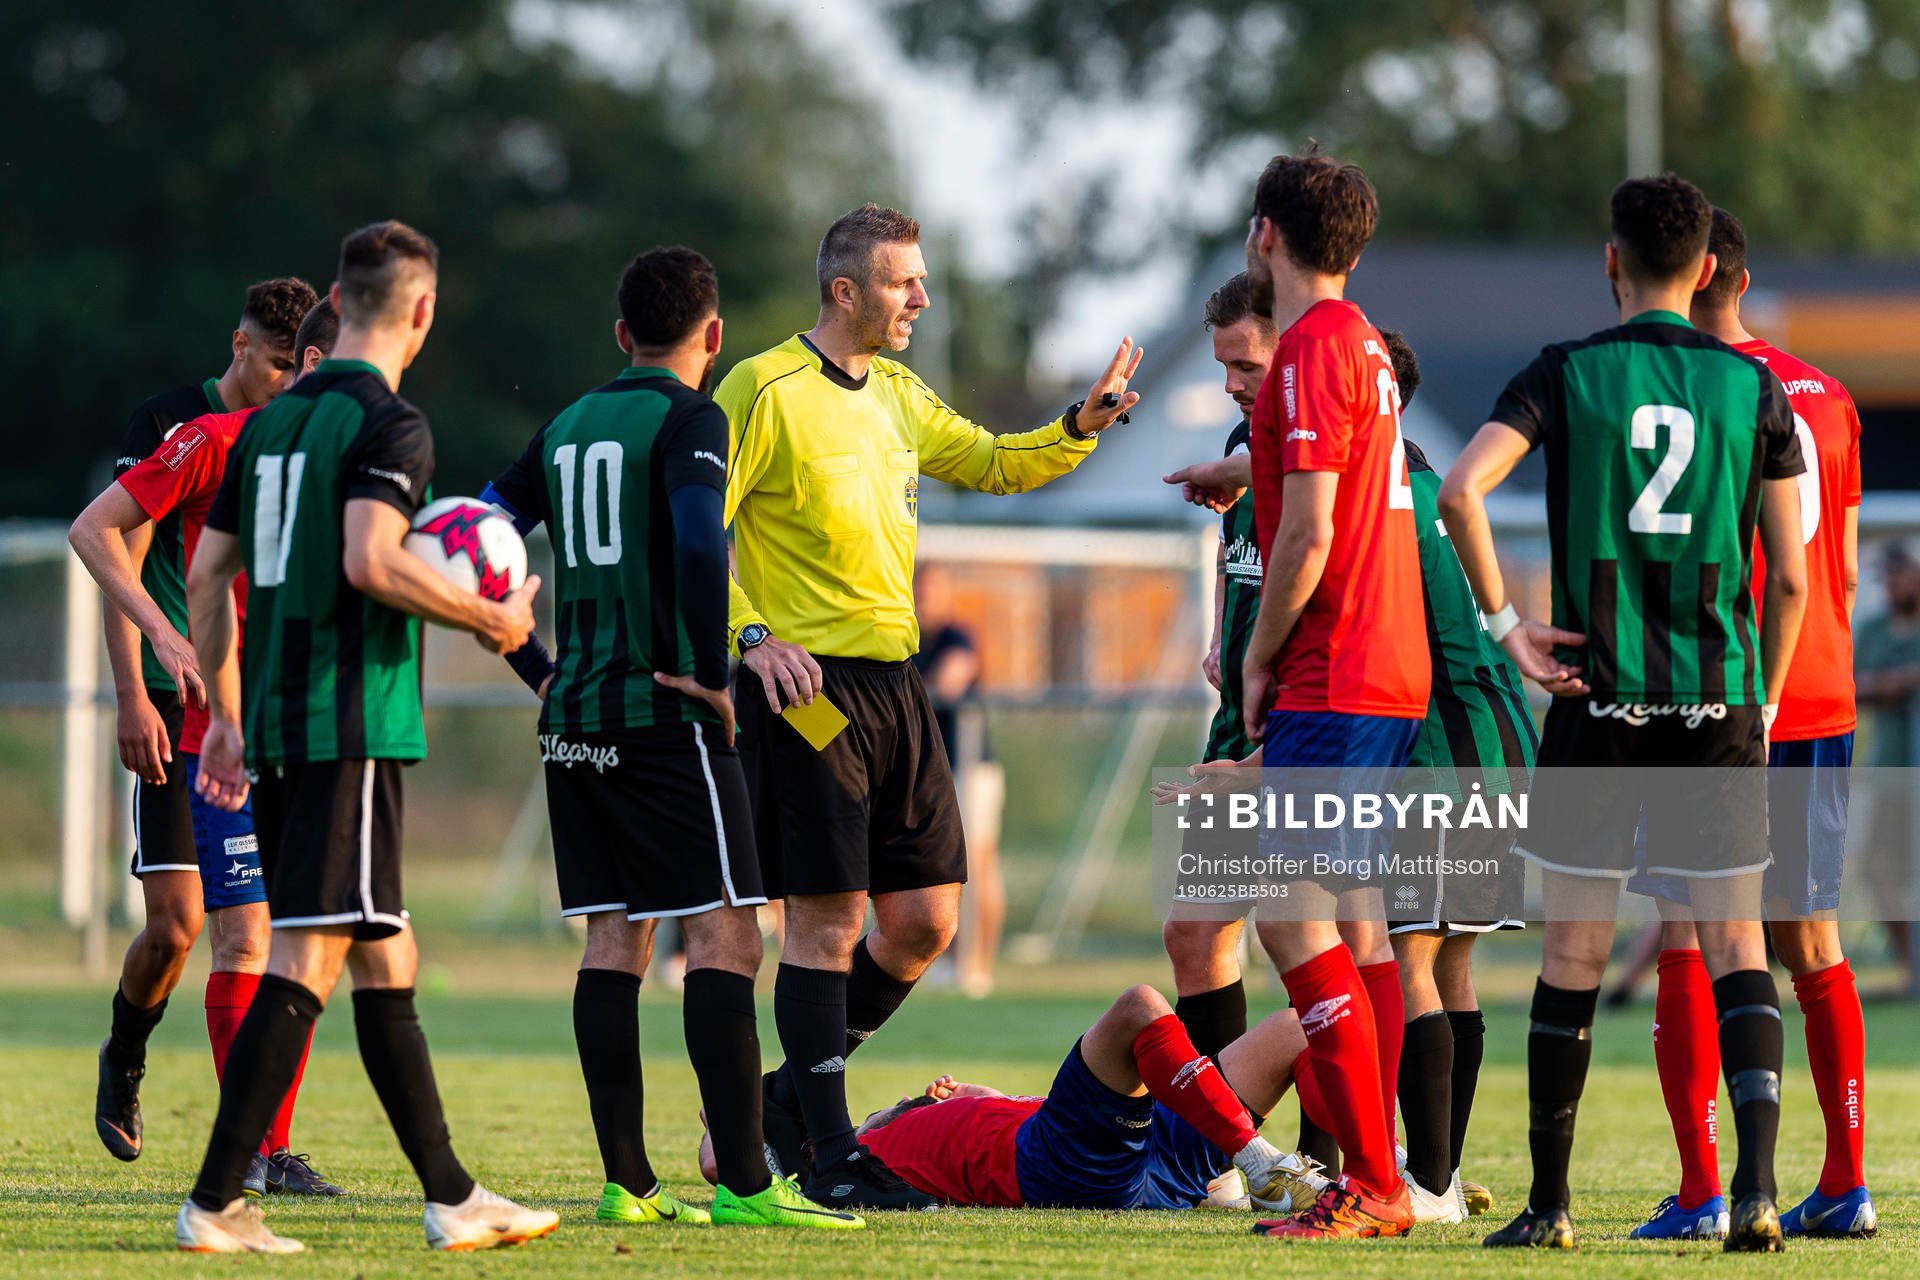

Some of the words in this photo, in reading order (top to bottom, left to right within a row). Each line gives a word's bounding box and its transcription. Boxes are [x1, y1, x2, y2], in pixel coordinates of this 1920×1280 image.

[1376, 366, 1414, 511] 2
[1628, 404, 1696, 535] 2
[254, 452, 307, 587] 11
[553, 440, 624, 568] 10
[1306, 1008, 1351, 1036] umbro
[1180, 1061, 1214, 1091] umbro
[1844, 1078, 1859, 1129] umbro
[1705, 1099, 1717, 1144] umbro
